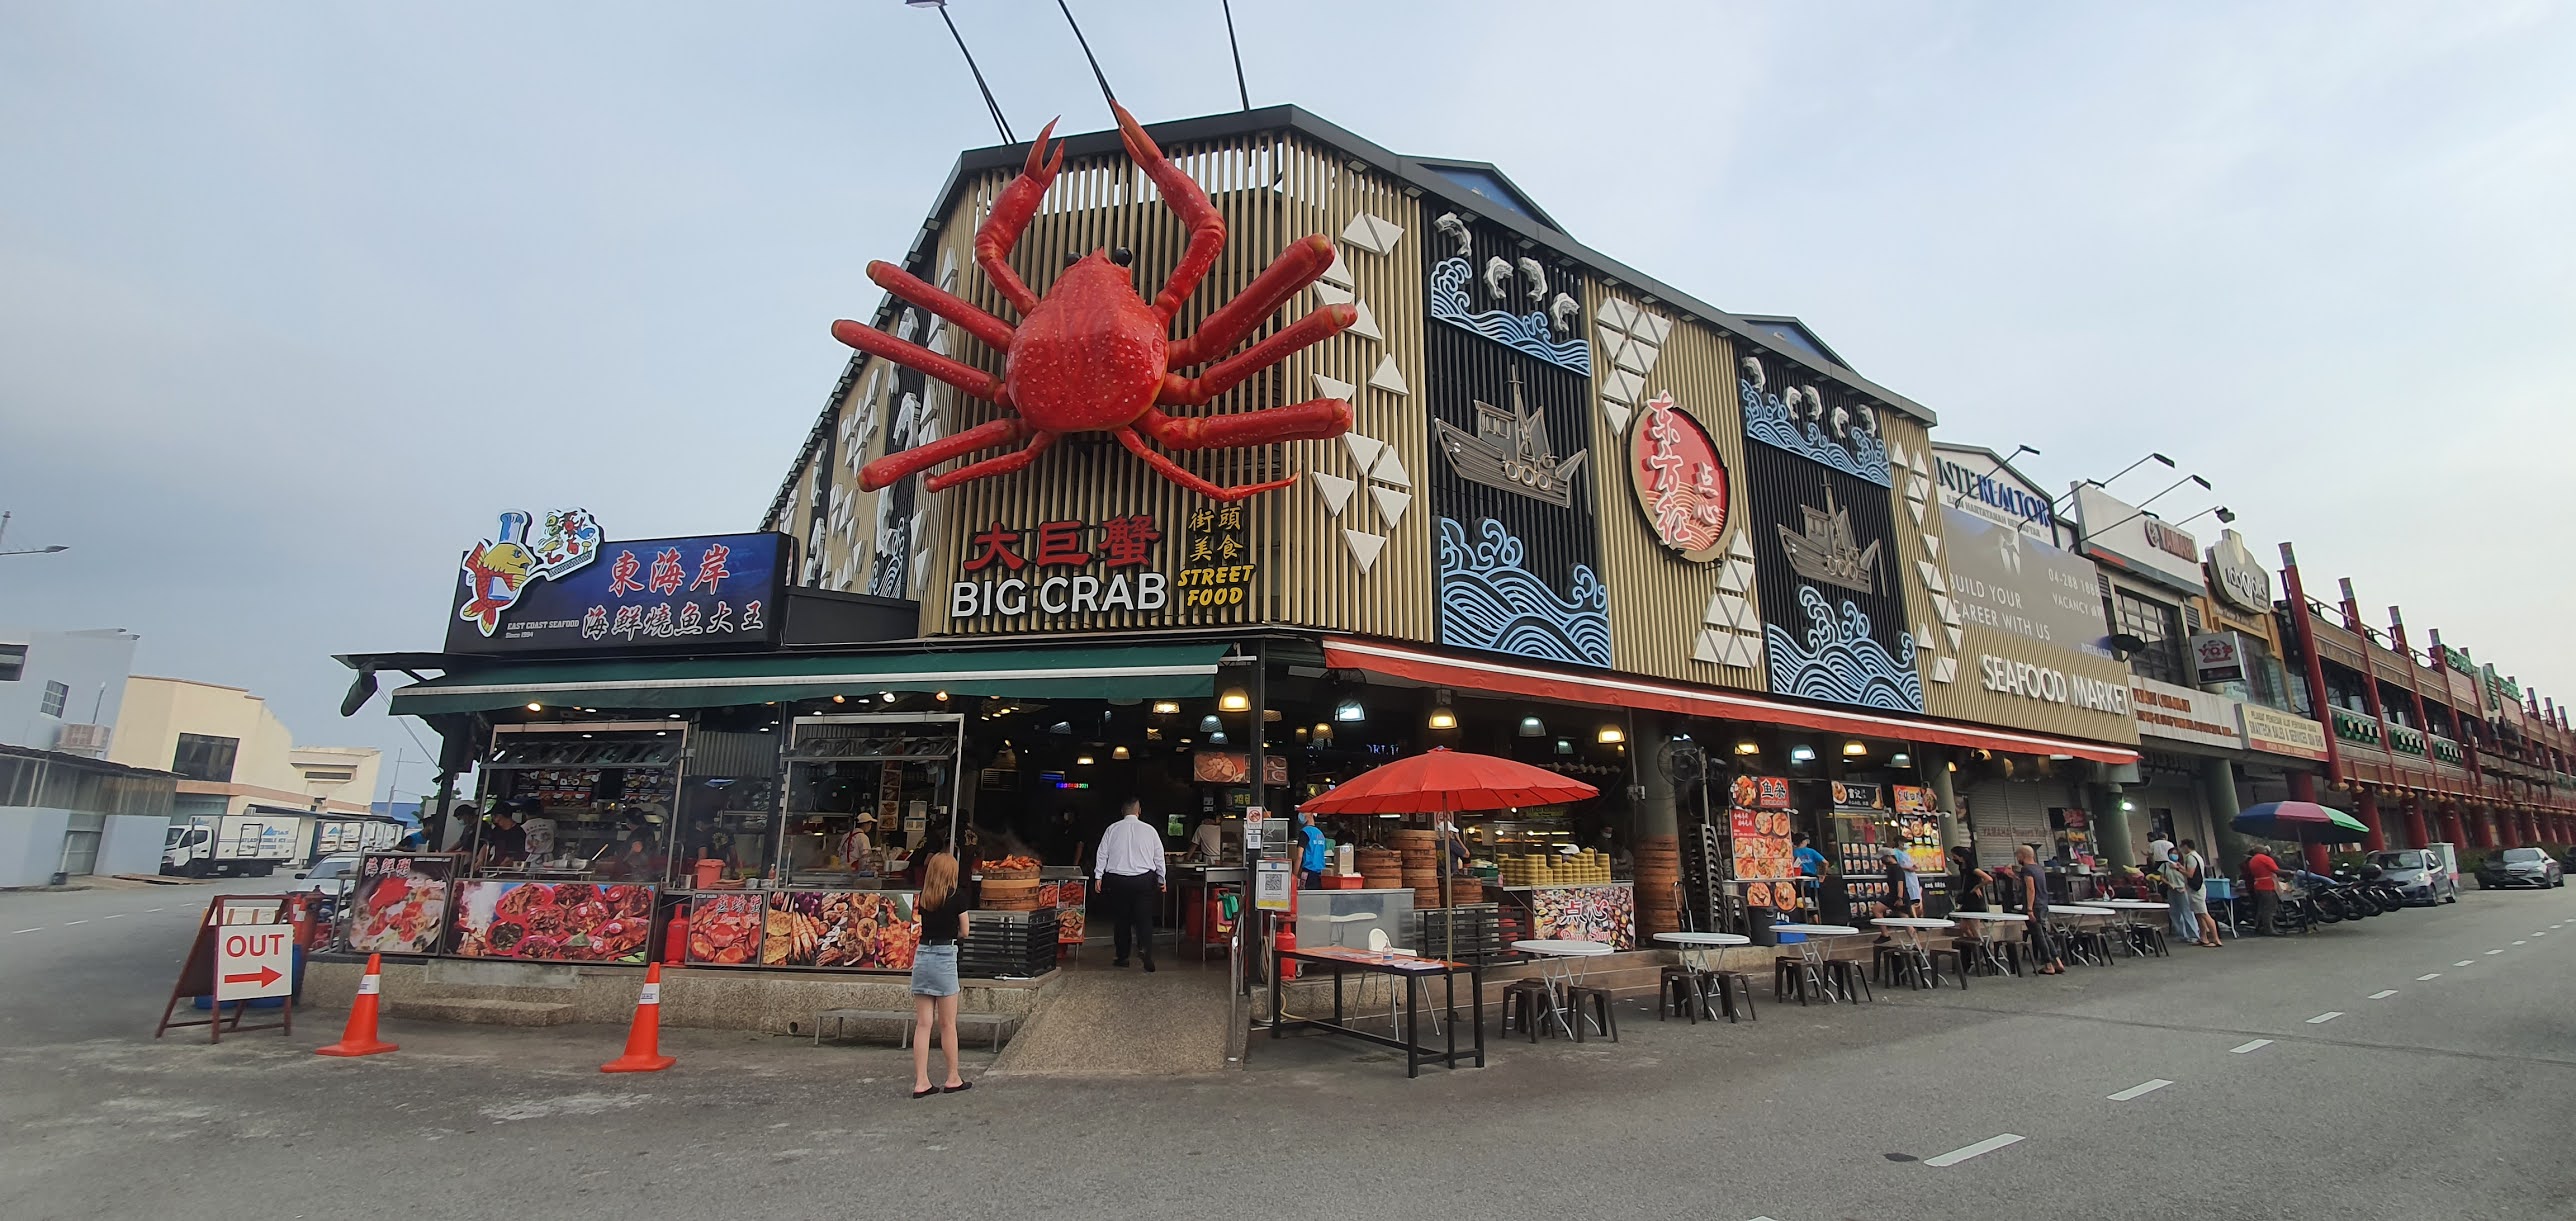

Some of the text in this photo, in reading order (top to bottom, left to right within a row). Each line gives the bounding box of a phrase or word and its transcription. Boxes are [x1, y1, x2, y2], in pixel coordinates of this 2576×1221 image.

[1932, 455, 2051, 527] NTEREALTOR
[1187, 506, 1242, 532] 街頭
[963, 514, 1162, 571] 大巨蟹
[1188, 536, 1243, 561] 美食
[608, 543, 731, 598] 東海岸
[1177, 563, 1256, 588] STREET
[951, 572, 1167, 618] BIG CRAB
[1186, 587, 1244, 608] FOOD
[1949, 572, 2023, 610] BUILD YOUR
[2052, 591, 2089, 616] VACANCY
[507, 619, 580, 631] EAST COAST SEAFOOD
[581, 600, 765, 642] 海鮮燒魚大王
[1952, 599, 2051, 642] CAREER WITH US
[1981, 653, 2068, 704] SEAFOOD
[2072, 674, 2129, 716] MARKET
[1560, 899, 1609, 926] 点心
[226, 933, 285, 959] OUT
